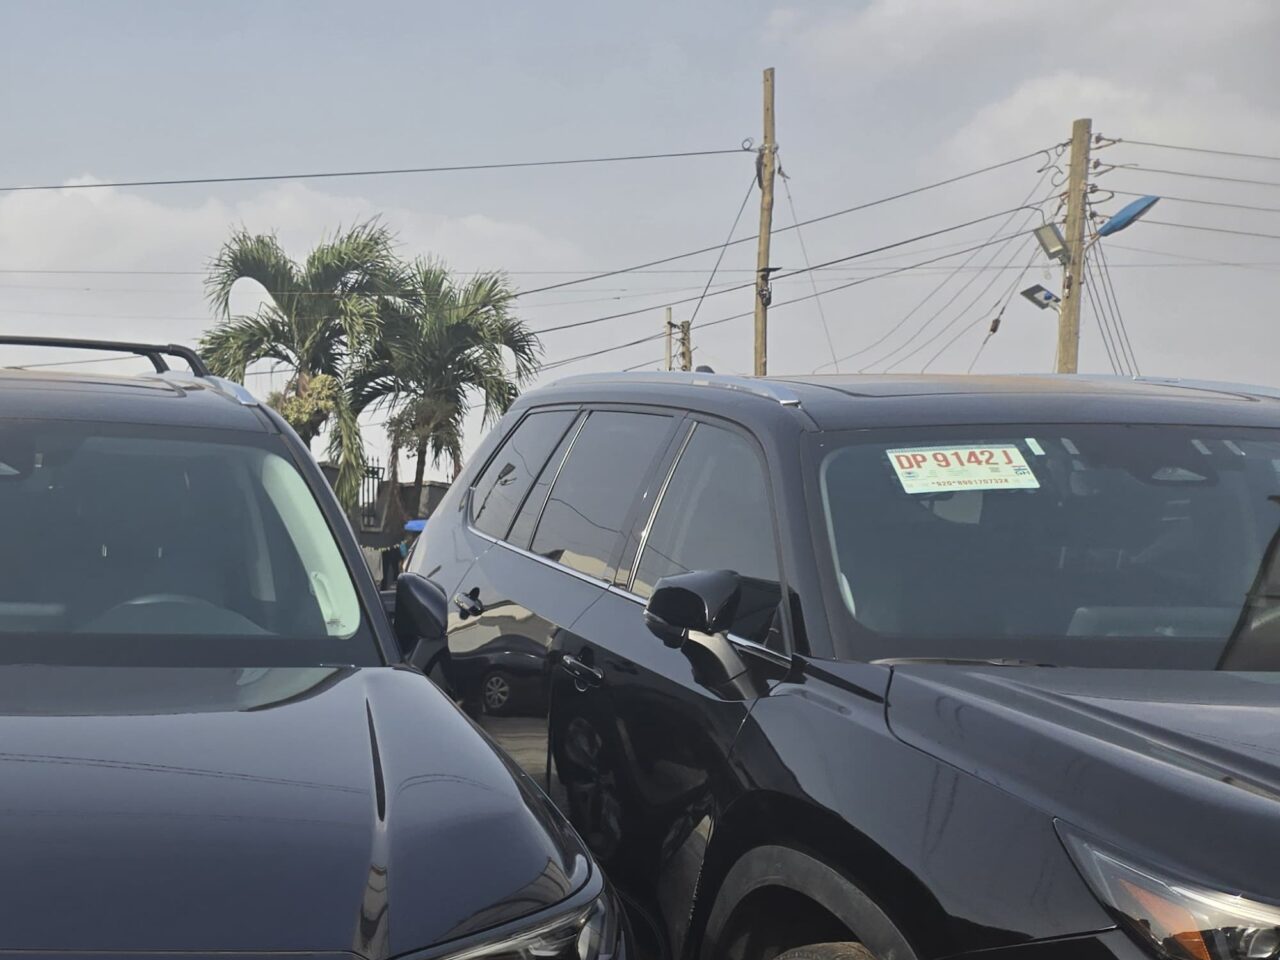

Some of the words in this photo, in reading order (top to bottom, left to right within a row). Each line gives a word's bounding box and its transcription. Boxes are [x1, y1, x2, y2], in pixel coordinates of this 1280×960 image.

[895, 453, 927, 470] DP
[932, 449, 999, 468] 9142
[1003, 450, 1014, 465] J
